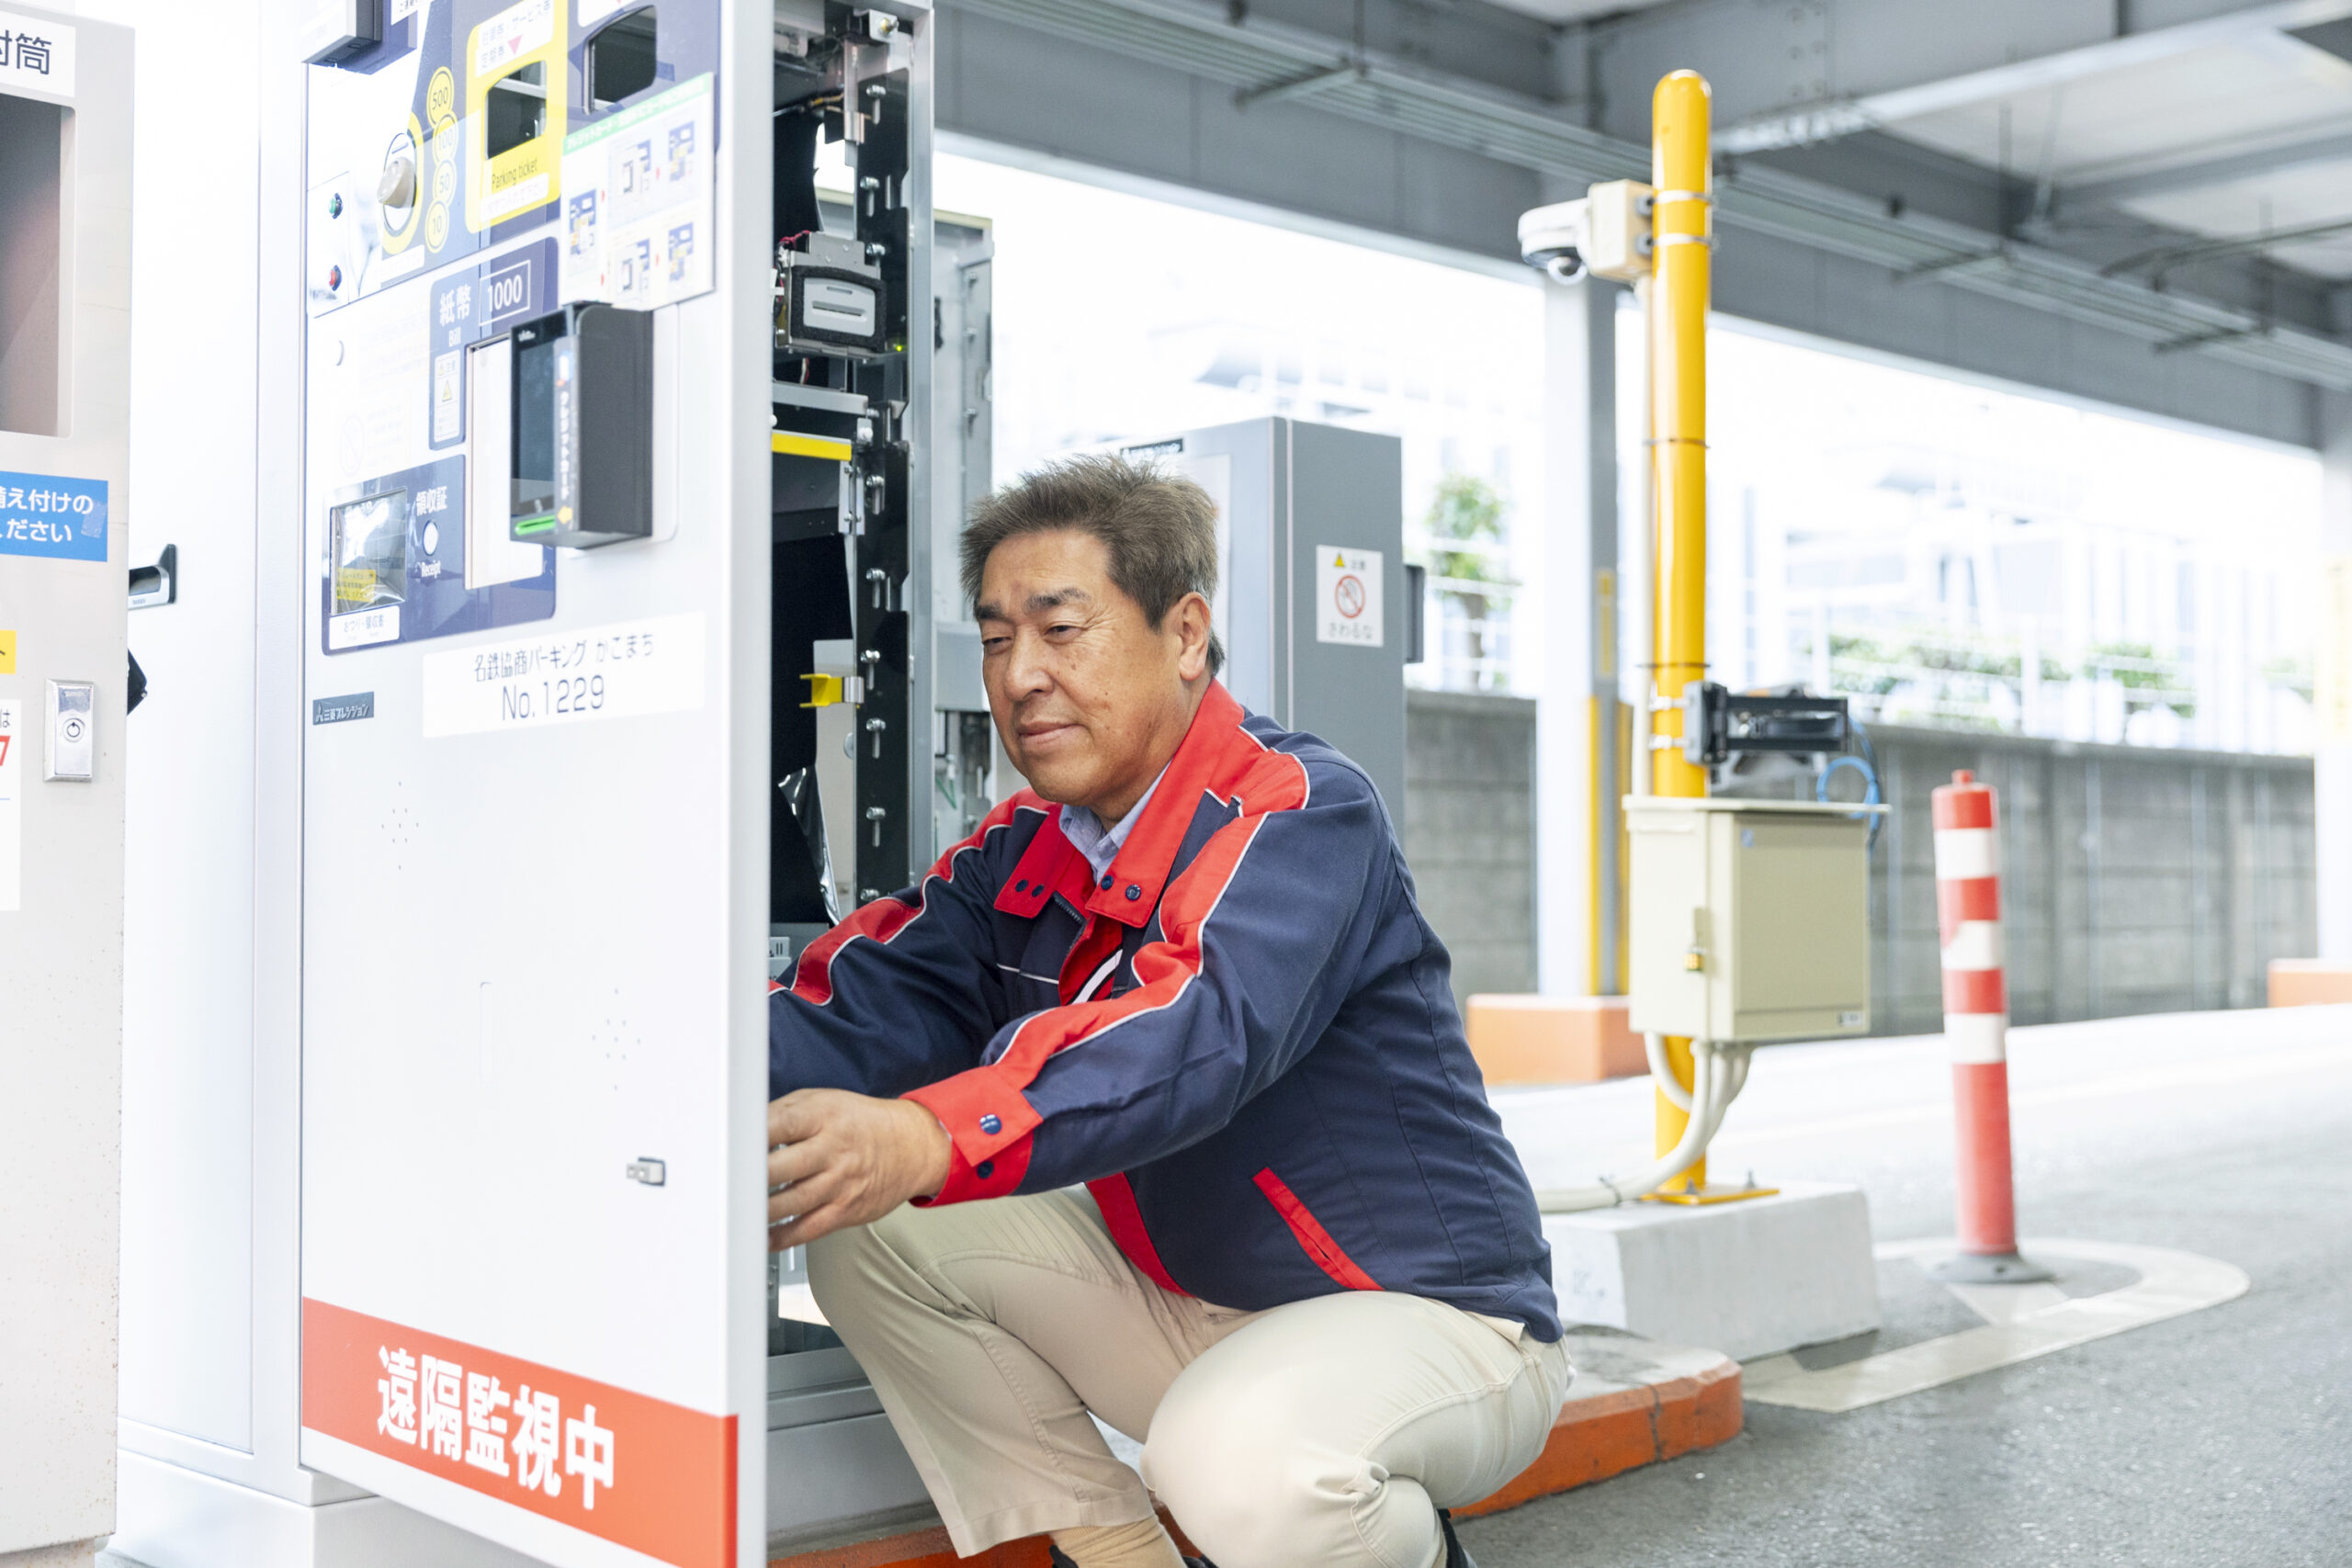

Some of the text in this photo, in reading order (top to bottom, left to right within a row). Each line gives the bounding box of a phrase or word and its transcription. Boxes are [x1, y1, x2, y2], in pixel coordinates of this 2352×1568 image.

[432, 86, 448, 110] 500
[437, 130, 454, 152] 100
[439, 174, 451, 193] 50
[492, 158, 537, 189] Parking ticket
[432, 216, 443, 236] 10
[439, 284, 472, 327] 紙幣
[487, 275, 523, 312] 1000
[448, 326, 461, 347] Bill
[416, 486, 447, 516] 領収証
[0, 518, 73, 543] ださい
[421, 561, 441, 579] Receipt
[1329, 623, 1374, 639] さわるな
[474, 639, 587, 682] 名鉄協商パーキング
[502, 674, 605, 721] No.1229
[377, 1344, 615, 1511] 遠隔監視中
